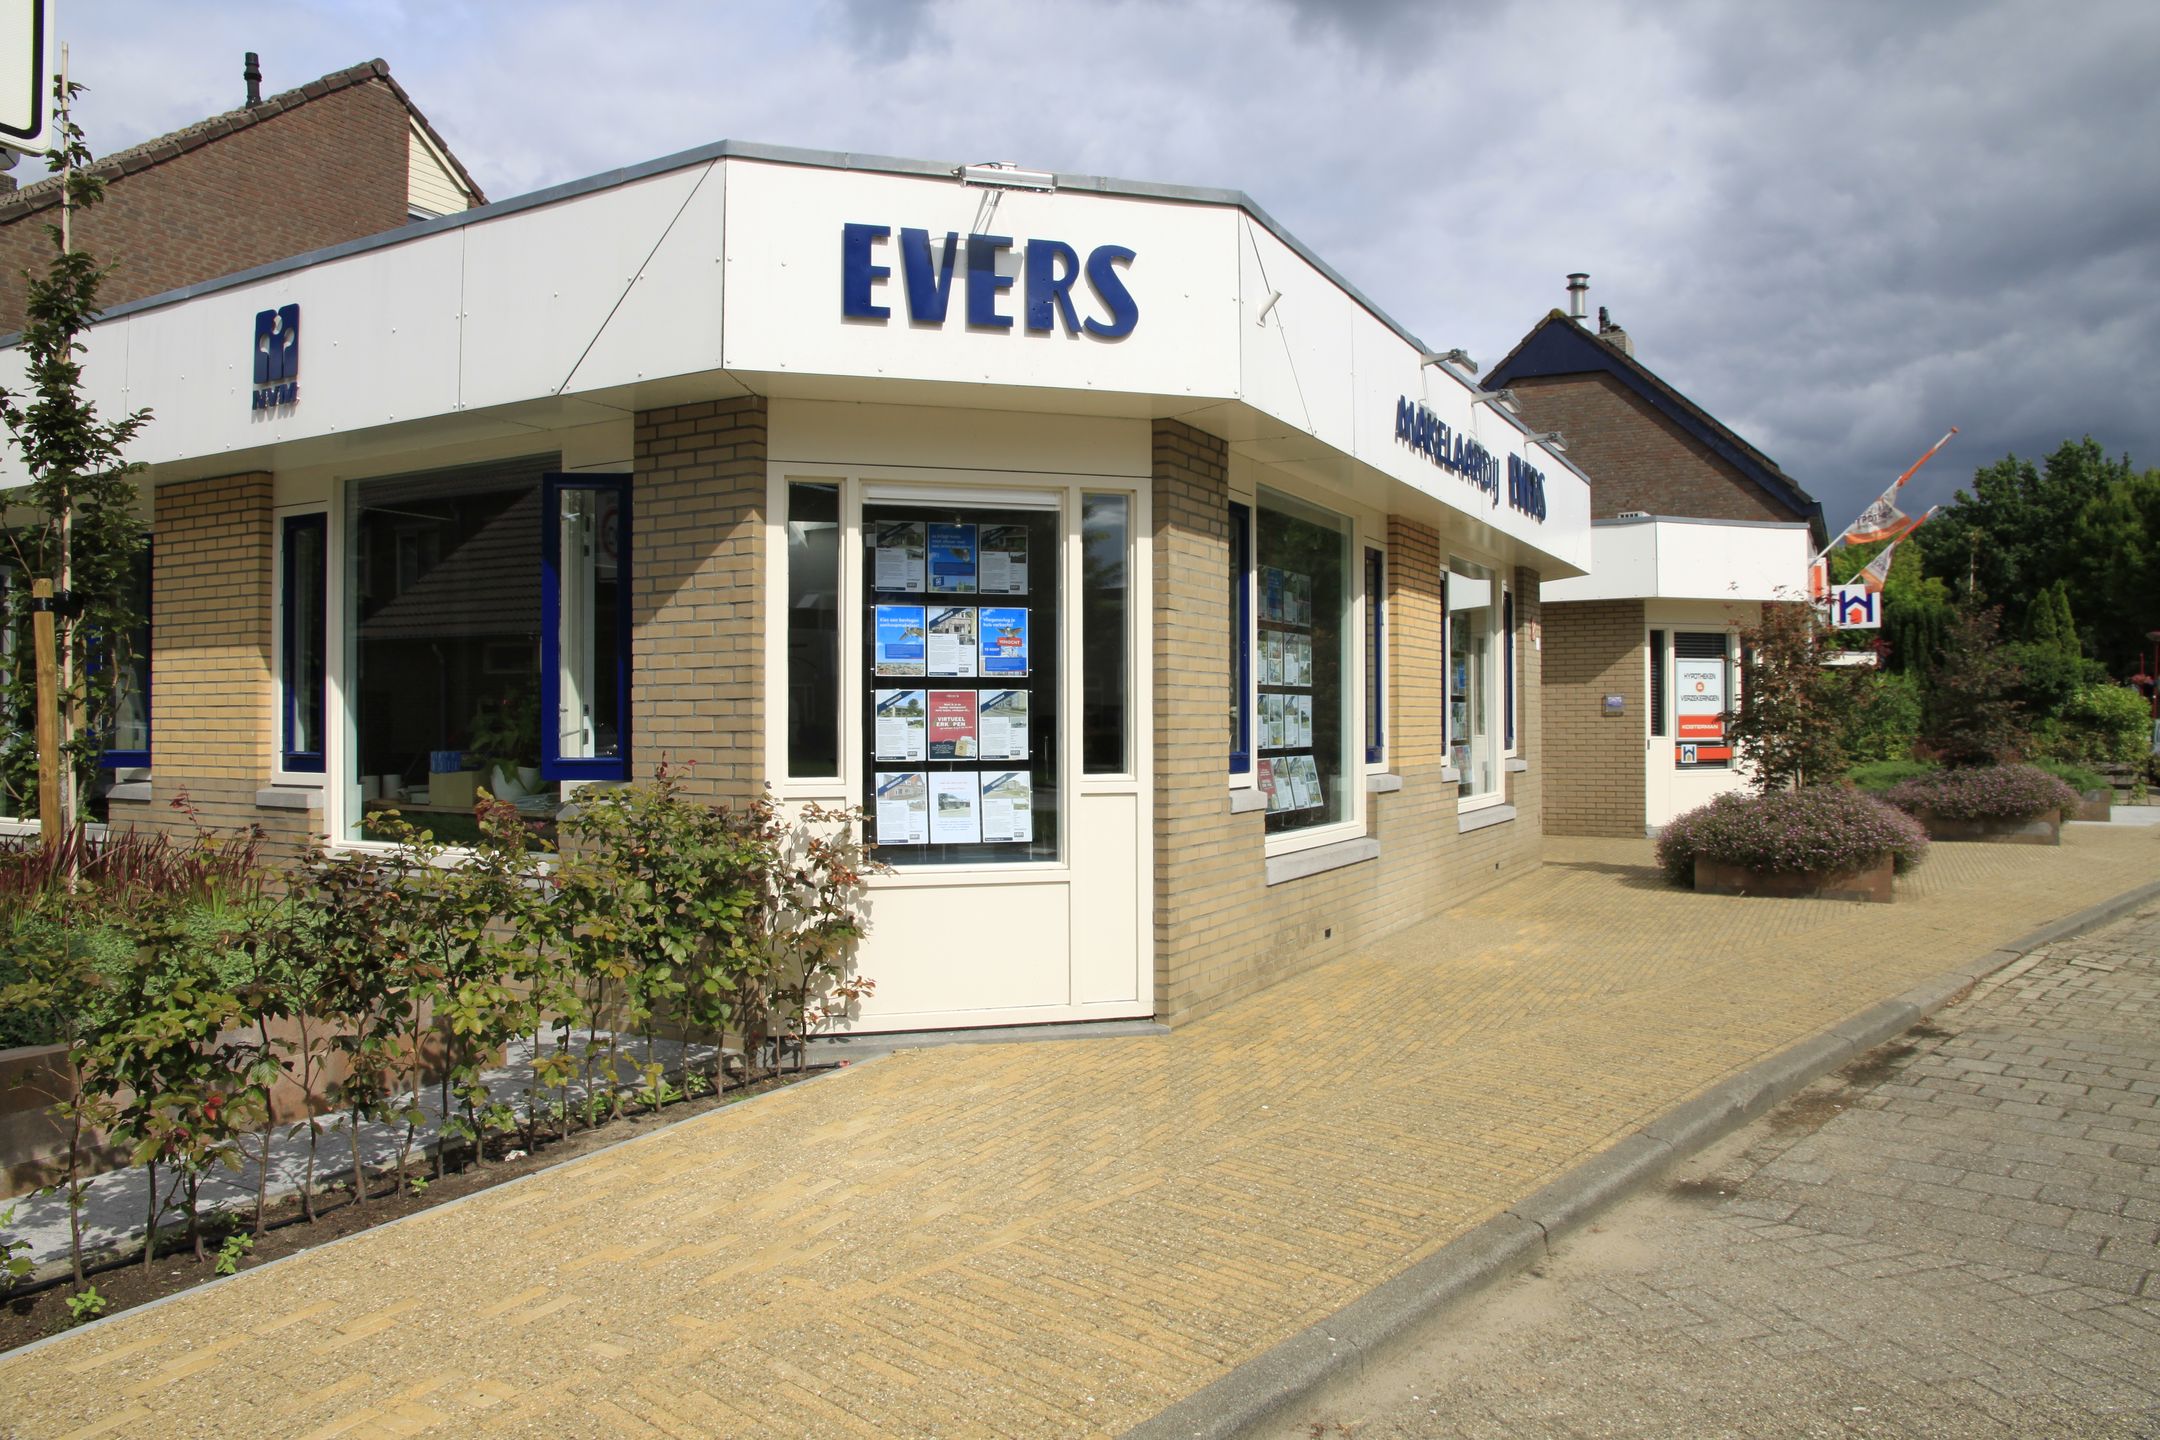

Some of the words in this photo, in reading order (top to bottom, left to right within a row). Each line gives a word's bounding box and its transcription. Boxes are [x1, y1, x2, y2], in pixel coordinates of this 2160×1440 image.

[843, 222, 1139, 338] EVERS
[252, 382, 298, 410] NVM
[1396, 394, 1500, 508] MAKELAARDIJ
